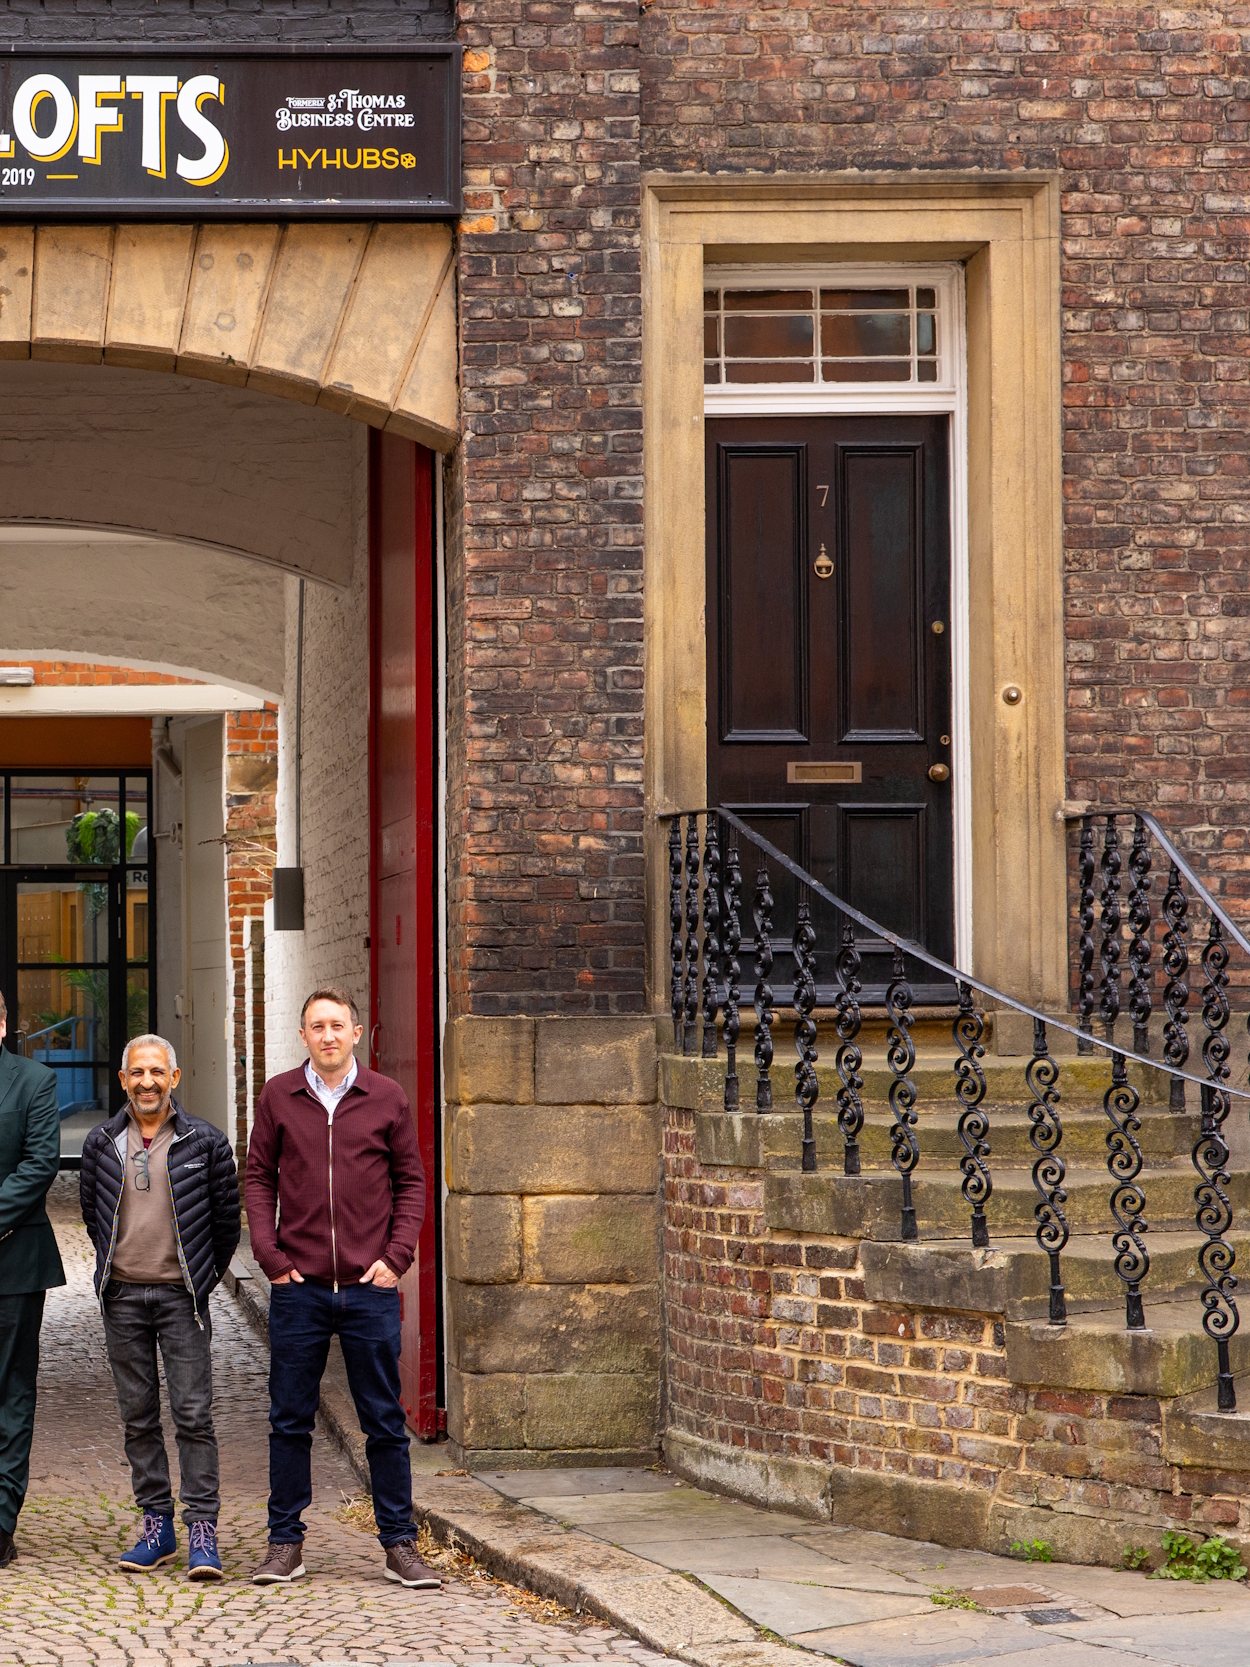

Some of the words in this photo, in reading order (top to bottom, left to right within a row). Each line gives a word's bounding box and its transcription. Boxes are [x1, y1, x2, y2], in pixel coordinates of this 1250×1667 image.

[285, 97, 326, 109] FORMERLY
[327, 94, 344, 112] ST
[339, 88, 406, 112] THOMAS
[275, 107, 354, 131] BUSINESS
[357, 108, 415, 131] CENTRE
[278, 148, 400, 170] HYHUBS
[1, 168, 35, 186] 2019
[816, 485, 830, 507] 7
